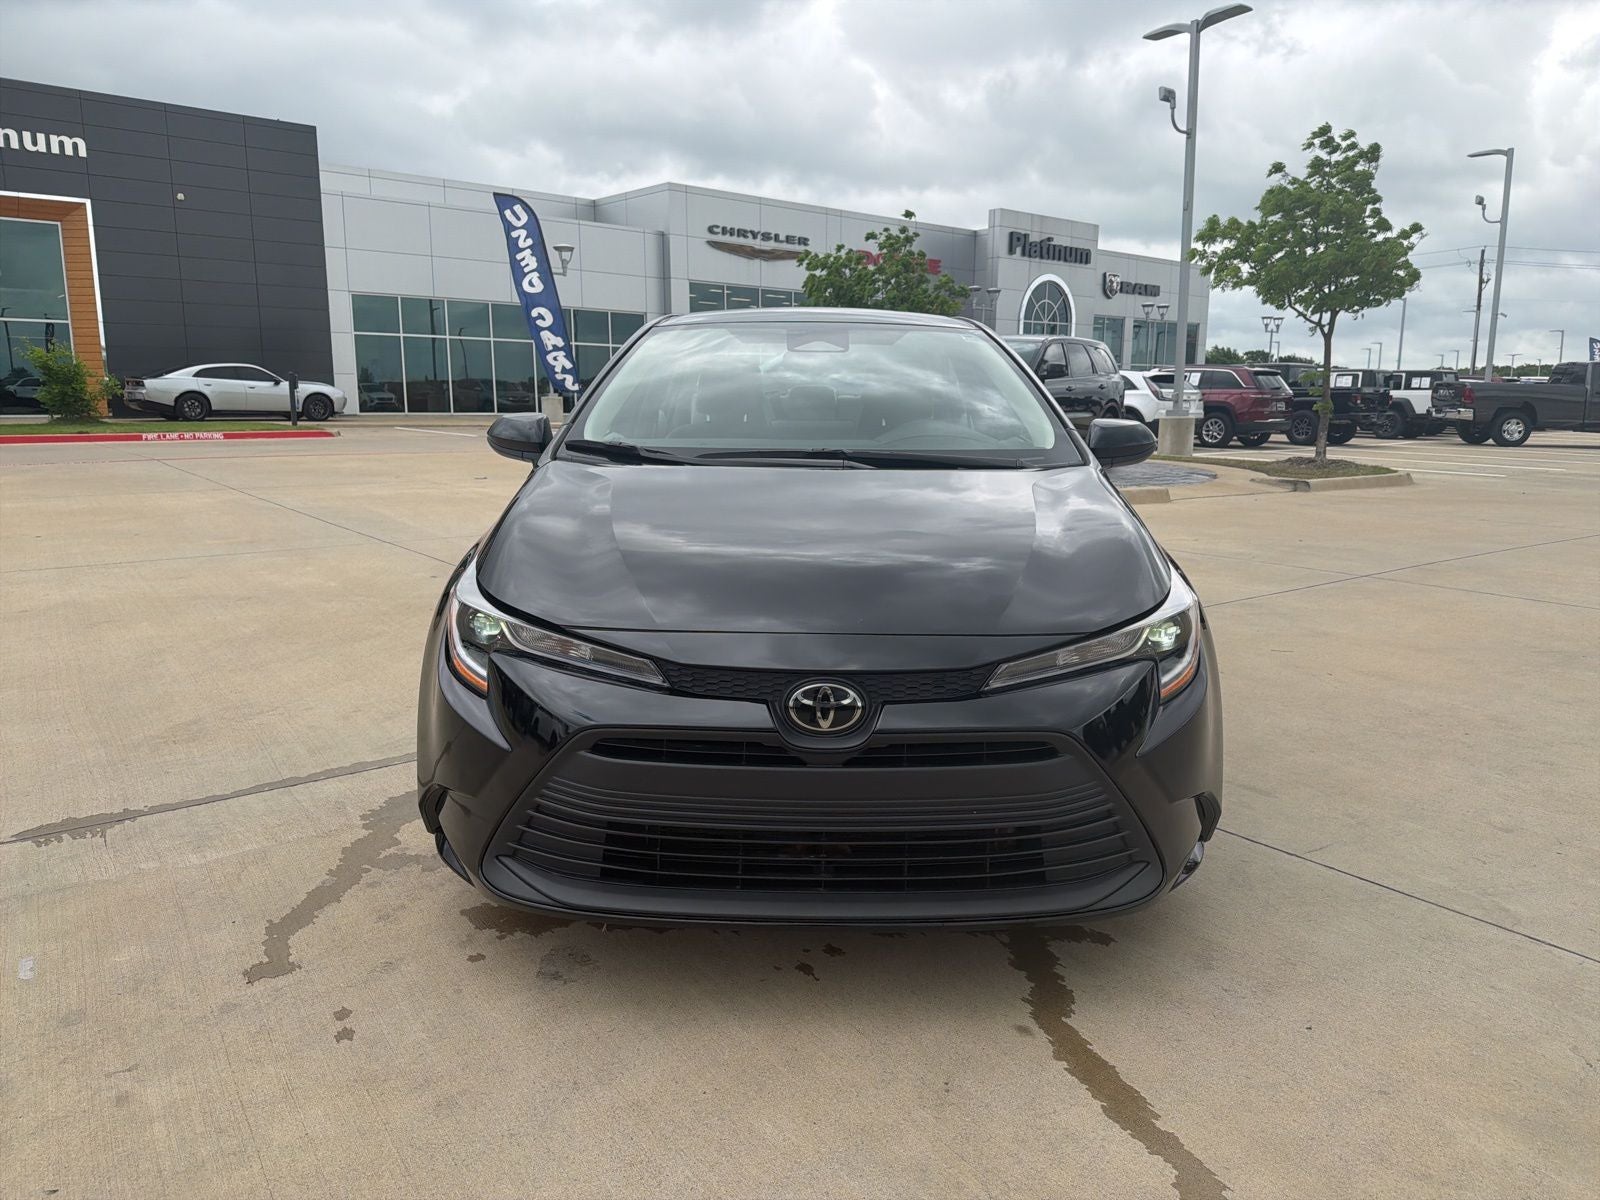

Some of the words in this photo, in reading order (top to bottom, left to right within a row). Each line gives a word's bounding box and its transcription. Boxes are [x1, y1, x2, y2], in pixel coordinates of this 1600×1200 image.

[707, 224, 810, 246] CHRYSLER
[1008, 231, 1092, 265] Platinum
[1120, 281, 1161, 297] RAM
[142, 433, 158, 441] FIRE
[160, 433, 179, 441] LANE
[184, 432, 194, 440] NO
[195, 432, 224, 440] PARKING
